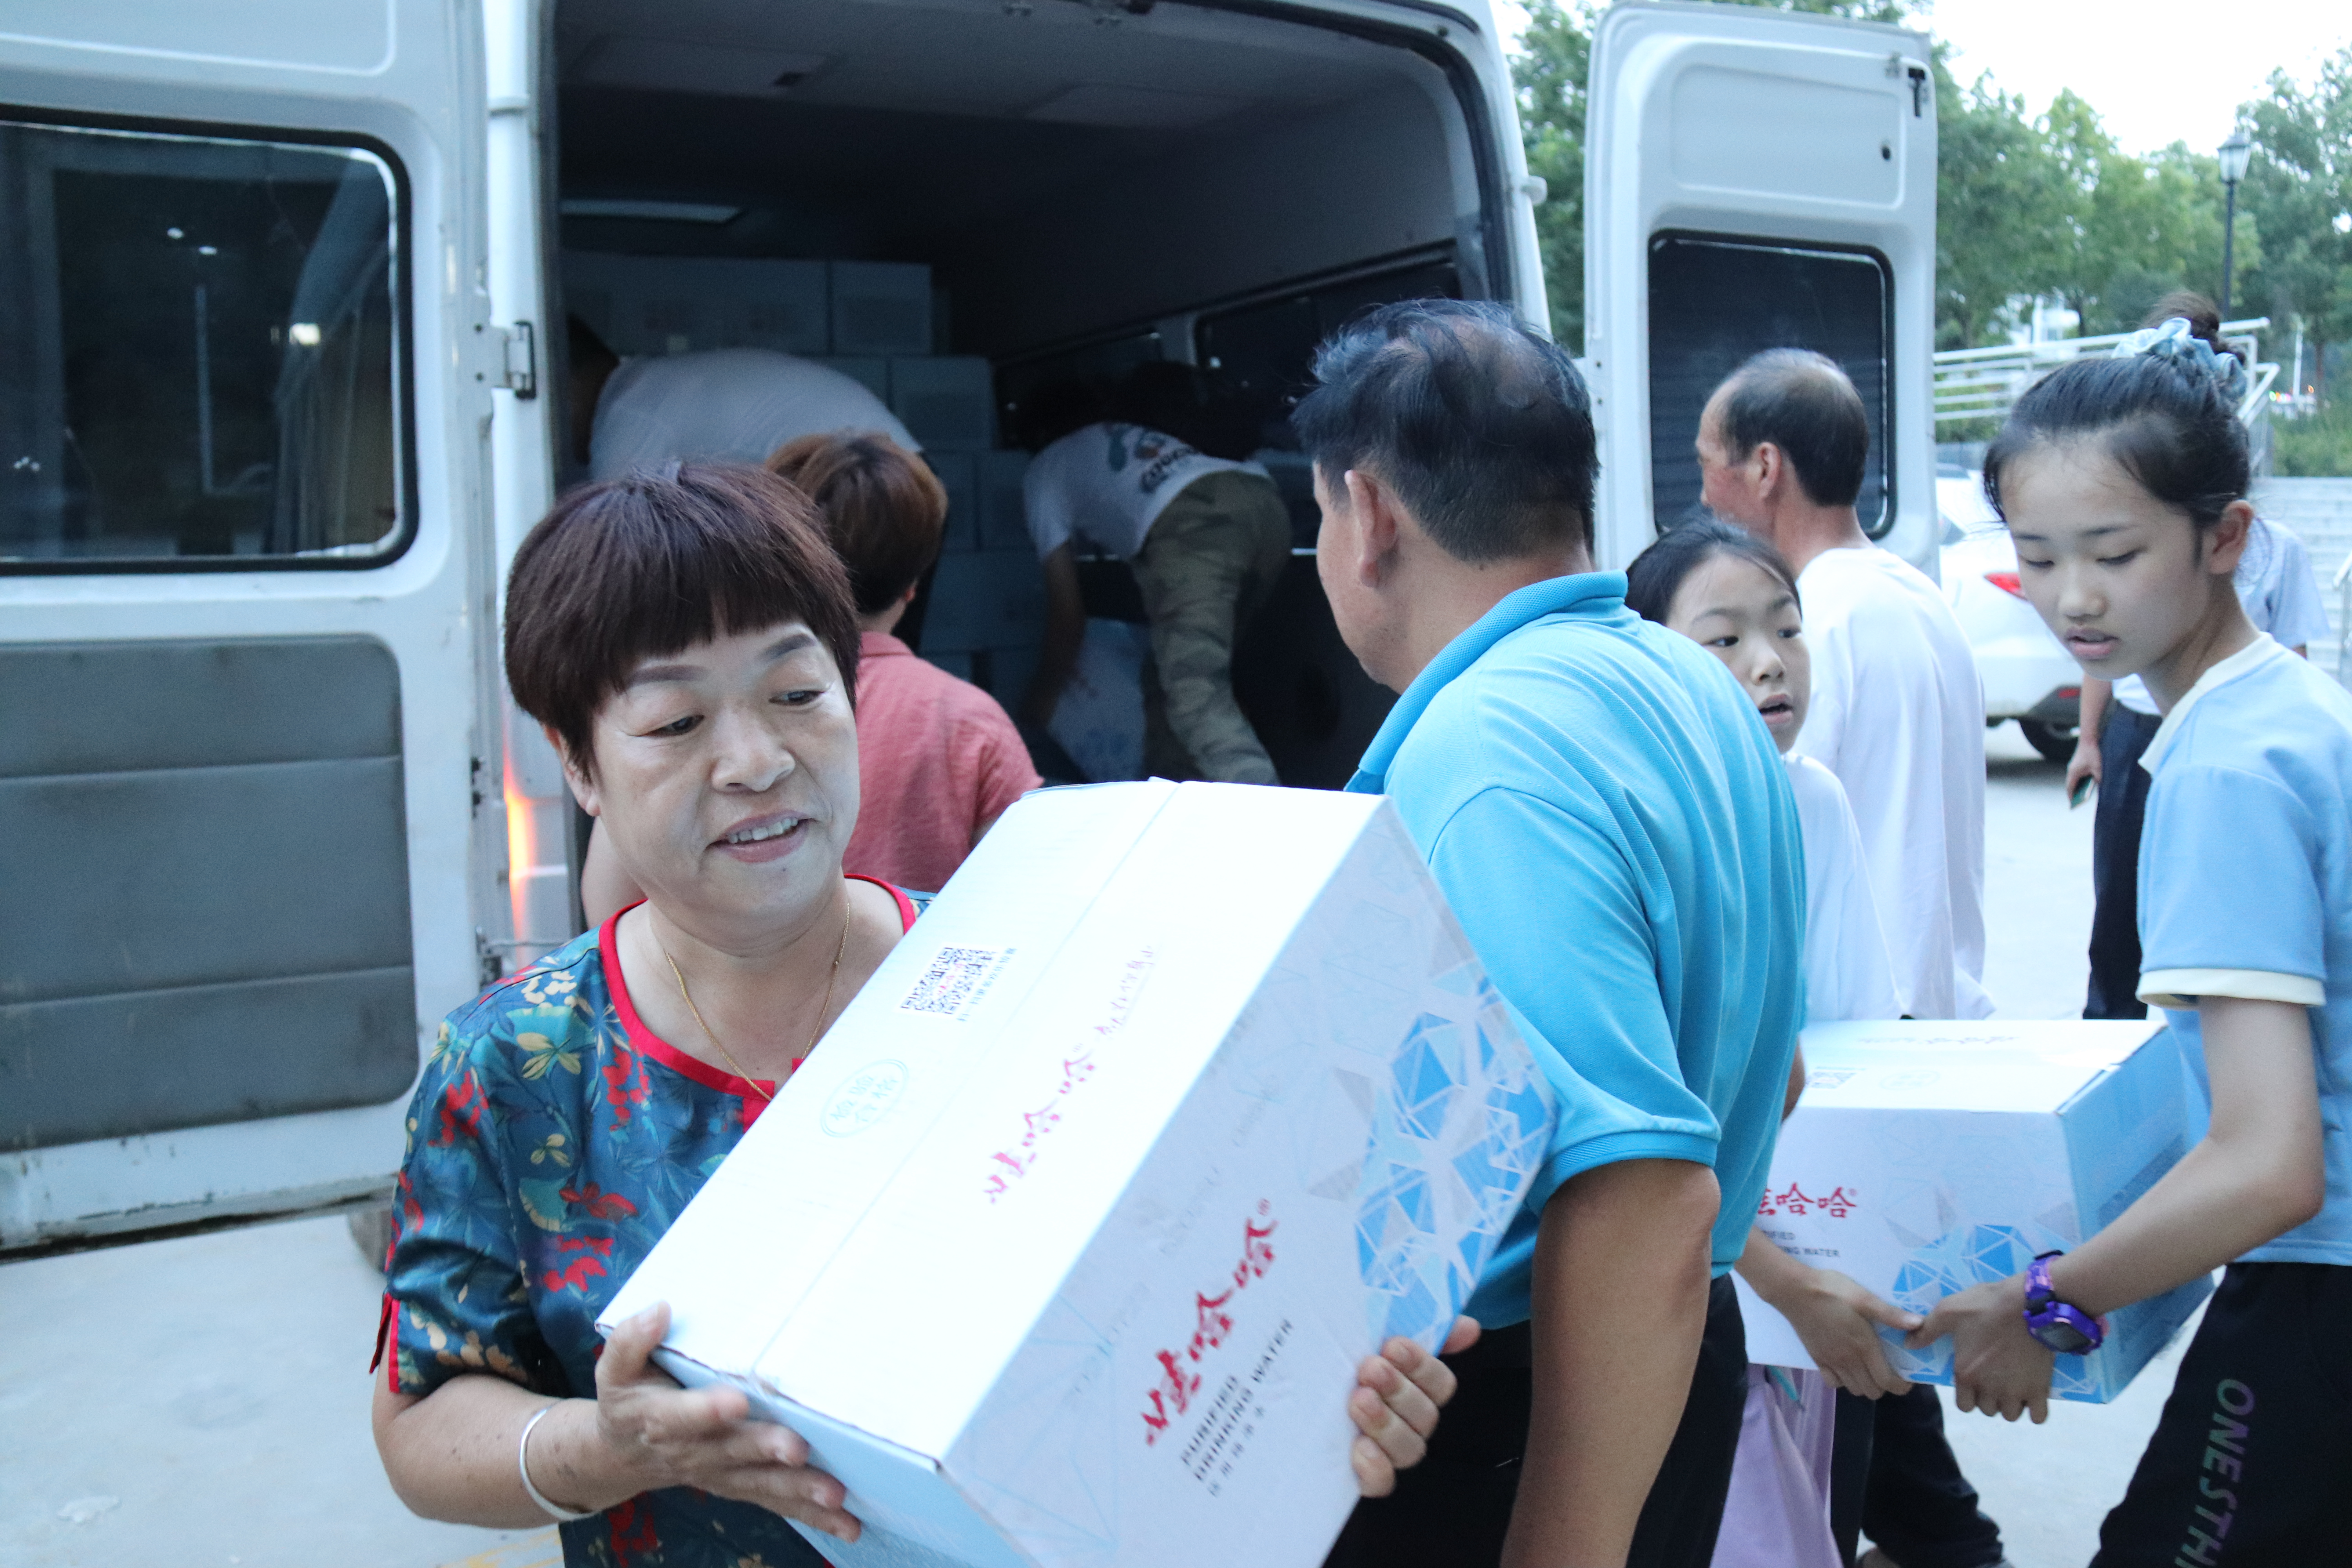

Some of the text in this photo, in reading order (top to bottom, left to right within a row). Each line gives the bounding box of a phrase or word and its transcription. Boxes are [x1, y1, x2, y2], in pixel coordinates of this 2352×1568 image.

[1141, 1216, 1279, 1447] 娃哈哈
[1804, 1248, 1839, 1258] WATER
[1181, 1375, 1238, 1466] PURIFIED
[1194, 1318, 1293, 1482] DRINKING WATER
[2174, 1378, 2255, 1568] ONESTH
